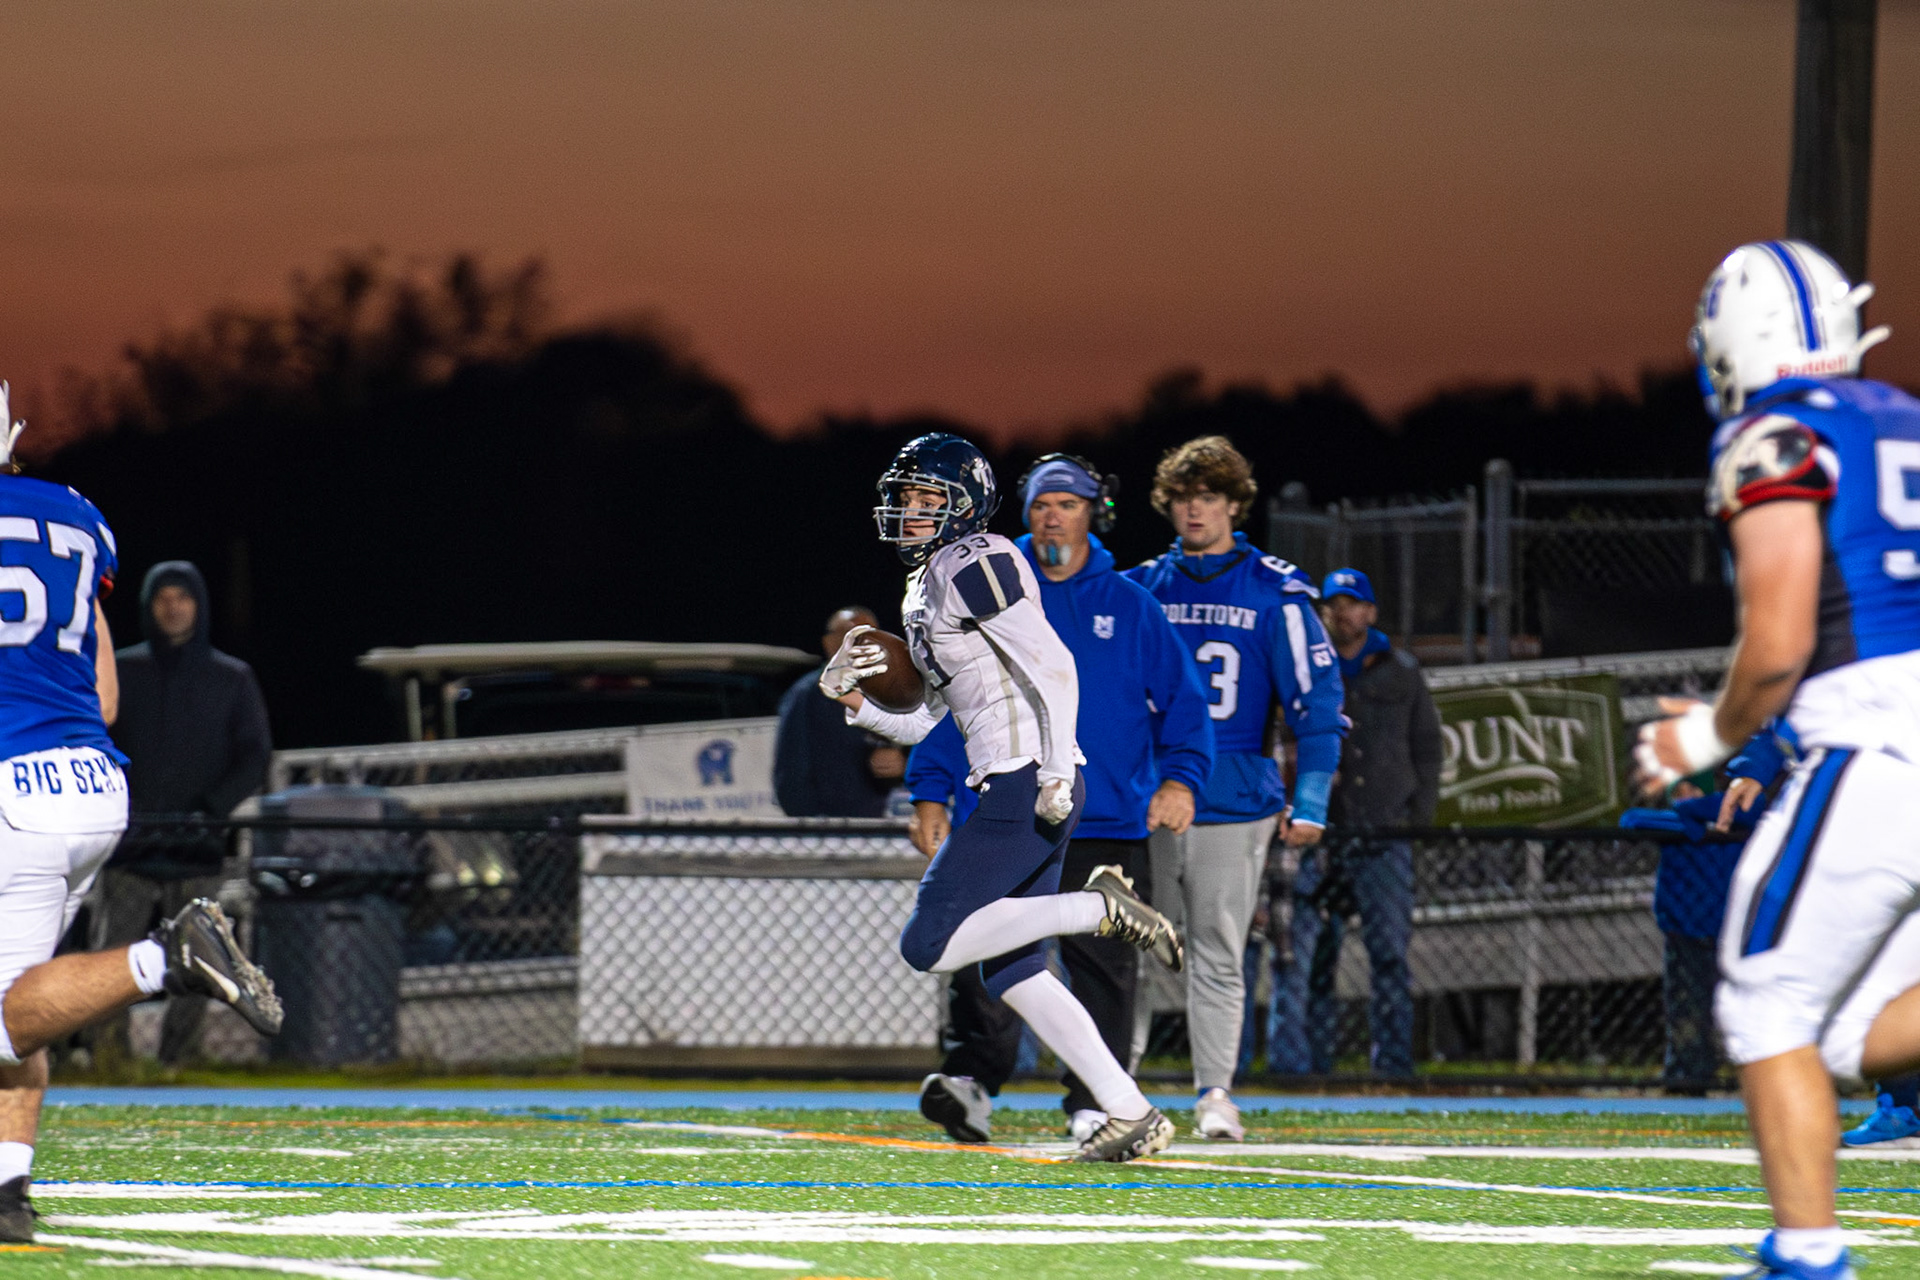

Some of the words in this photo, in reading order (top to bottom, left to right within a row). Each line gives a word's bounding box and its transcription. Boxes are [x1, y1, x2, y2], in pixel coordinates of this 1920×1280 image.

[0, 517, 98, 656] 57
[952, 535, 990, 559] 33
[1195, 641, 1241, 721] 3
